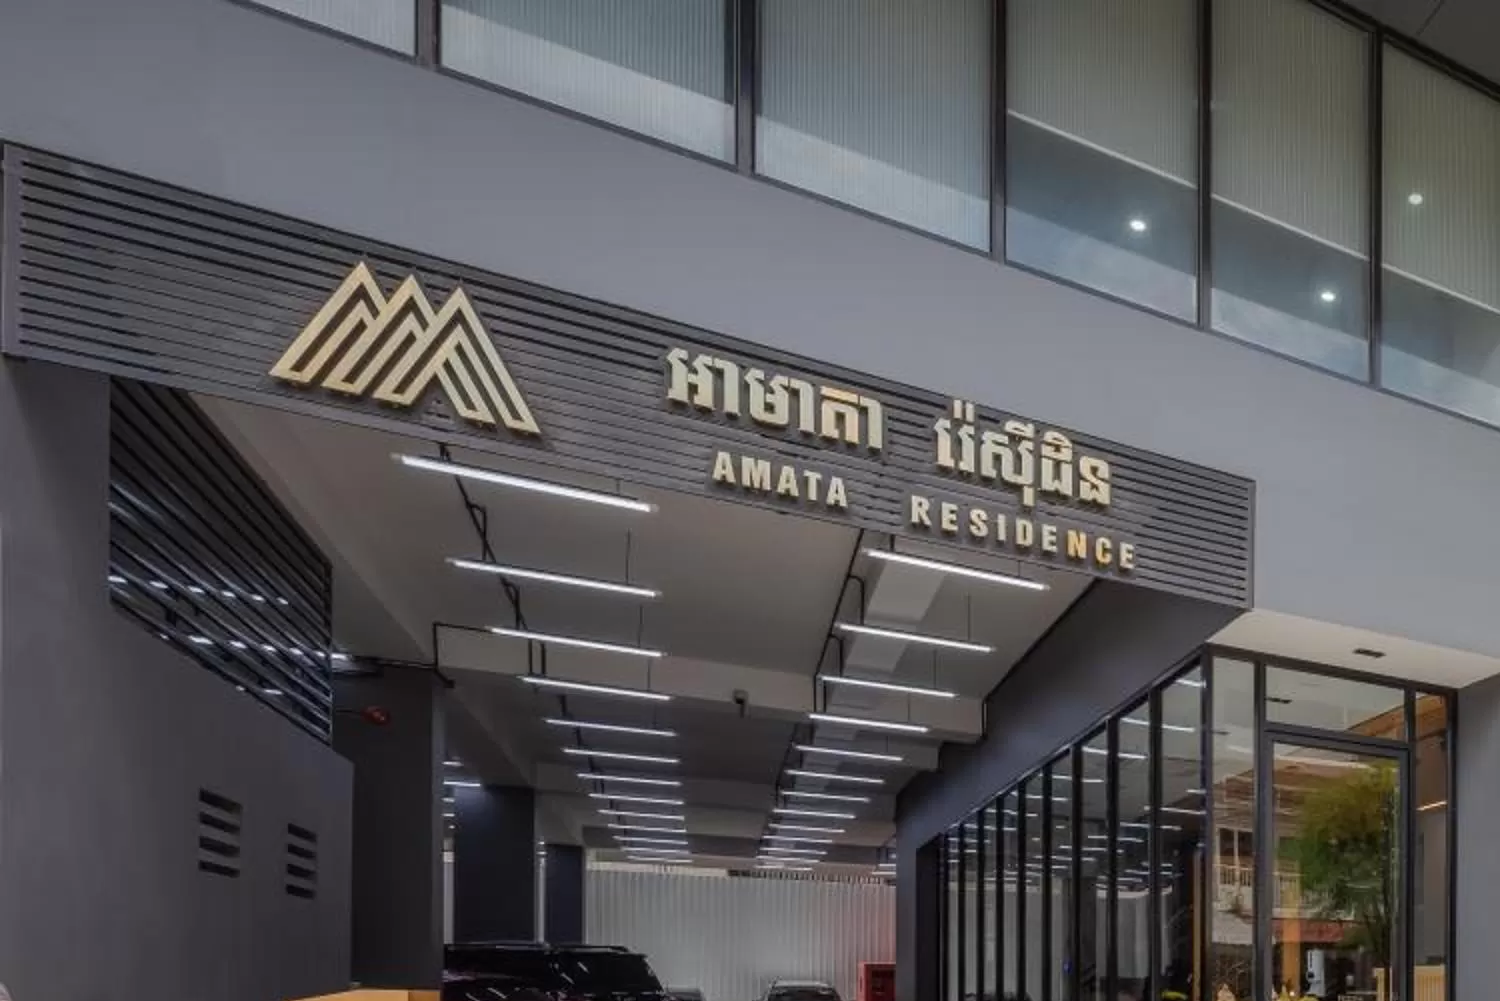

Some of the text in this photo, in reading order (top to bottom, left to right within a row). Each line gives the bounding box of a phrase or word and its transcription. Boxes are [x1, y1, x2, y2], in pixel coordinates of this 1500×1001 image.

[667, 347, 884, 450] អាមាតា
[711, 451, 1137, 570] AMATA RESIDENCE
